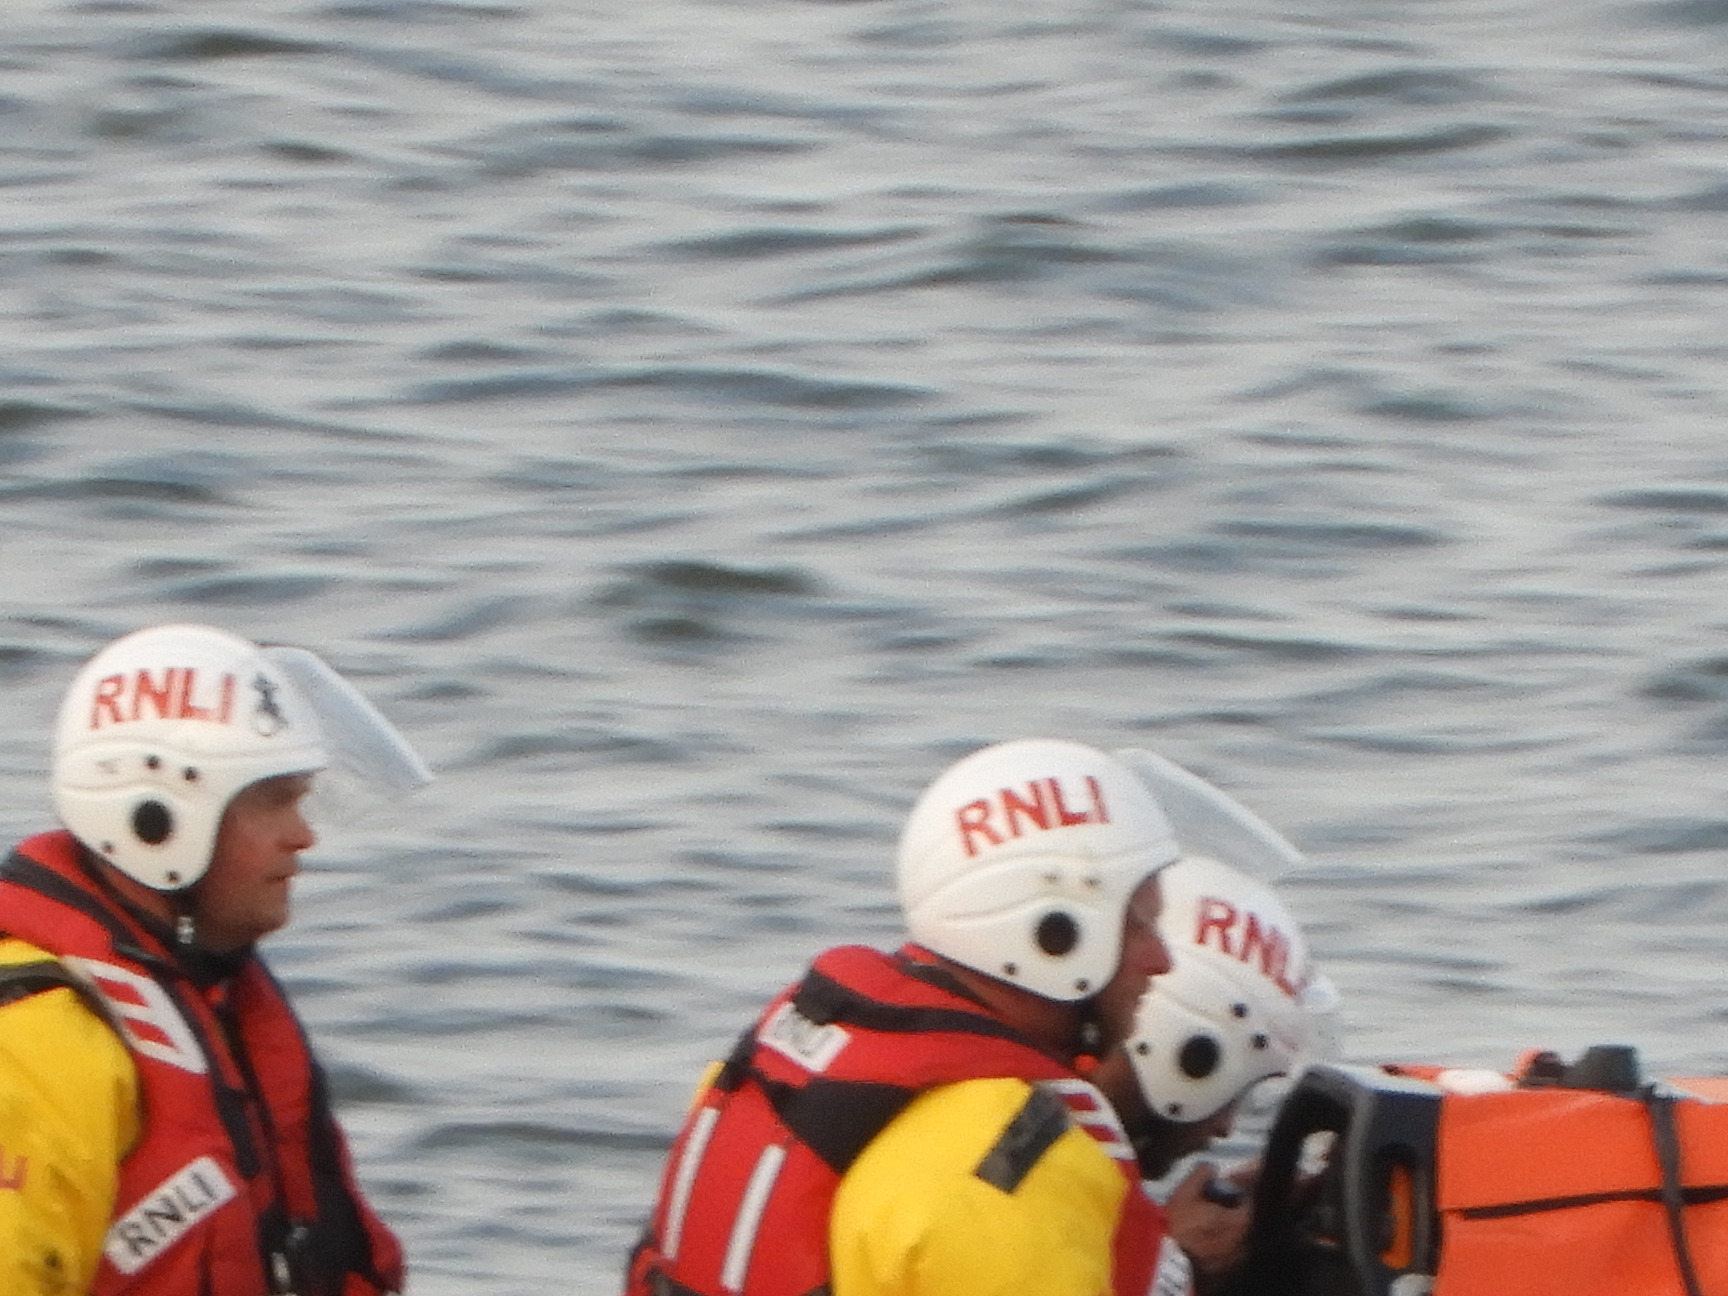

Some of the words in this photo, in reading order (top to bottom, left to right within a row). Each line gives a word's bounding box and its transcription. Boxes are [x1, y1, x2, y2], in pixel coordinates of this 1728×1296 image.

[91, 667, 238, 731] RNLI
[955, 776, 1110, 857] RNLI
[120, 1170, 218, 1258] RNLI
